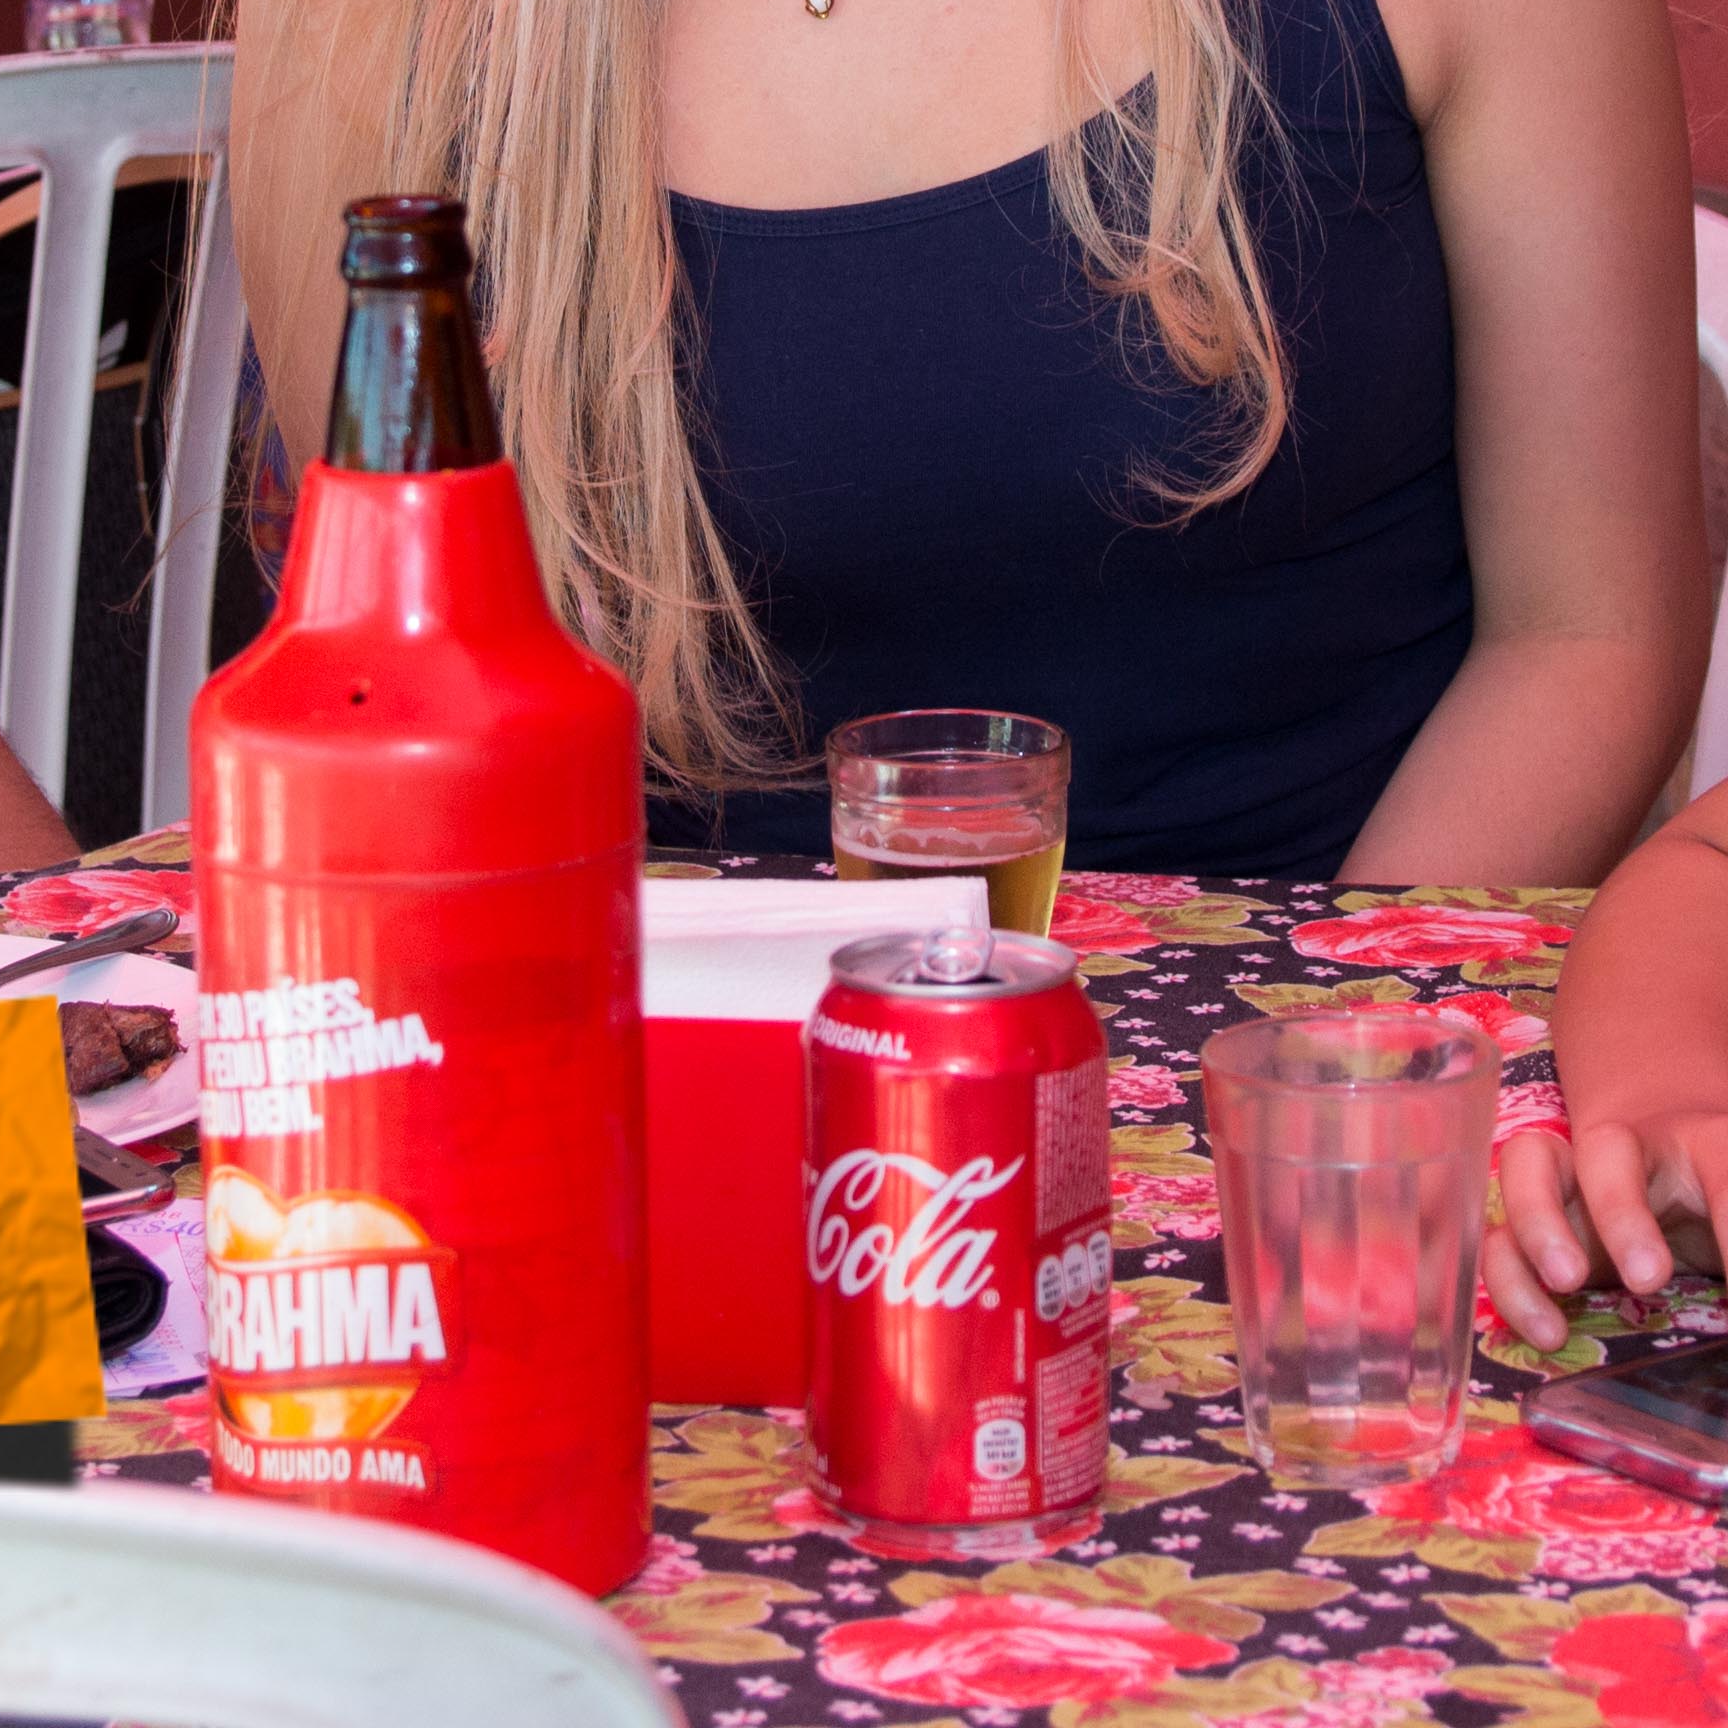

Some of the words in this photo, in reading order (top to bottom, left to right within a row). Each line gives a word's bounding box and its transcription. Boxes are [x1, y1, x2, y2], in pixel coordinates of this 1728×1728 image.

[267, 1013, 445, 1087] BRAHMA,
[814, 1012, 913, 1062] ORIGINAL
[807, 1148, 1025, 1310] Cola
[207, 1262, 448, 1373] BRAHMA
[259, 1446, 353, 1483] MUNDO
[358, 1448, 427, 1490] AMA
